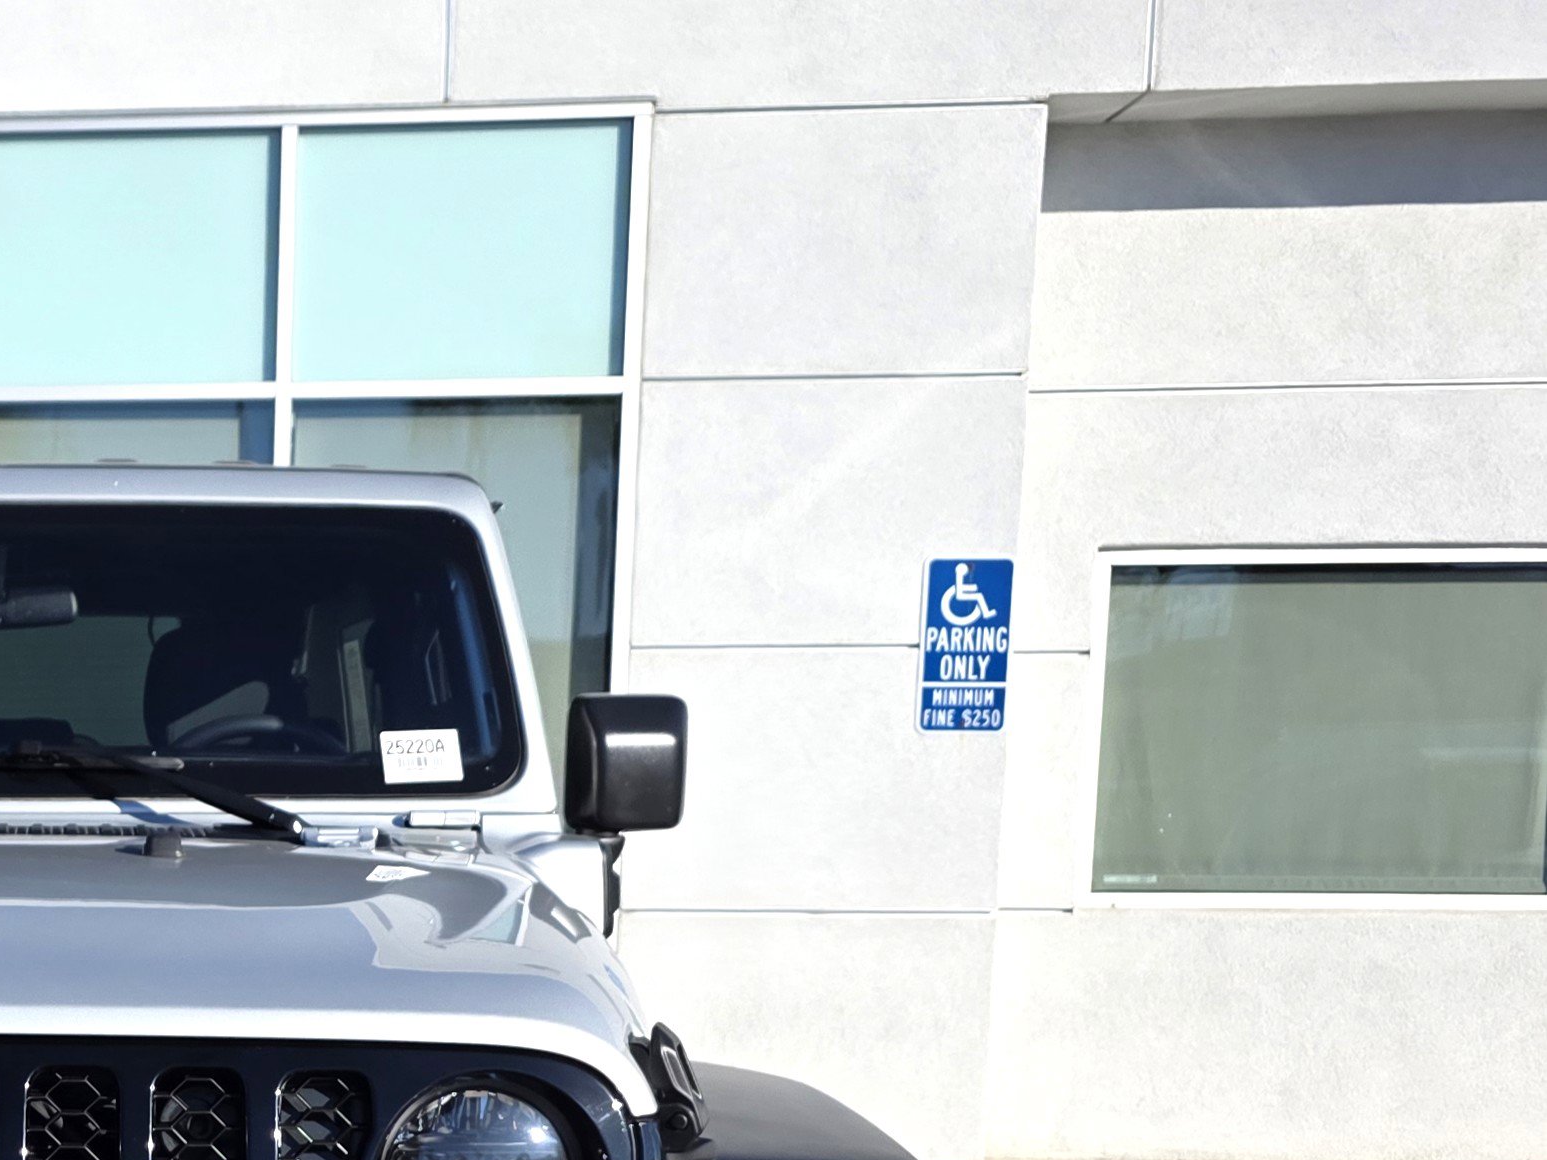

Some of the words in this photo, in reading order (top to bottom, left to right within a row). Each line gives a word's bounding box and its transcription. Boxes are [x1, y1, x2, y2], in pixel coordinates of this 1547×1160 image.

[926, 627, 1008, 653] PARKING
[940, 655, 990, 680] ONLY
[933, 689, 994, 706] MINIMUM
[923, 708, 956, 728] FINE
[962, 709, 1001, 728] $250
[386, 739, 445, 755] 25220A
